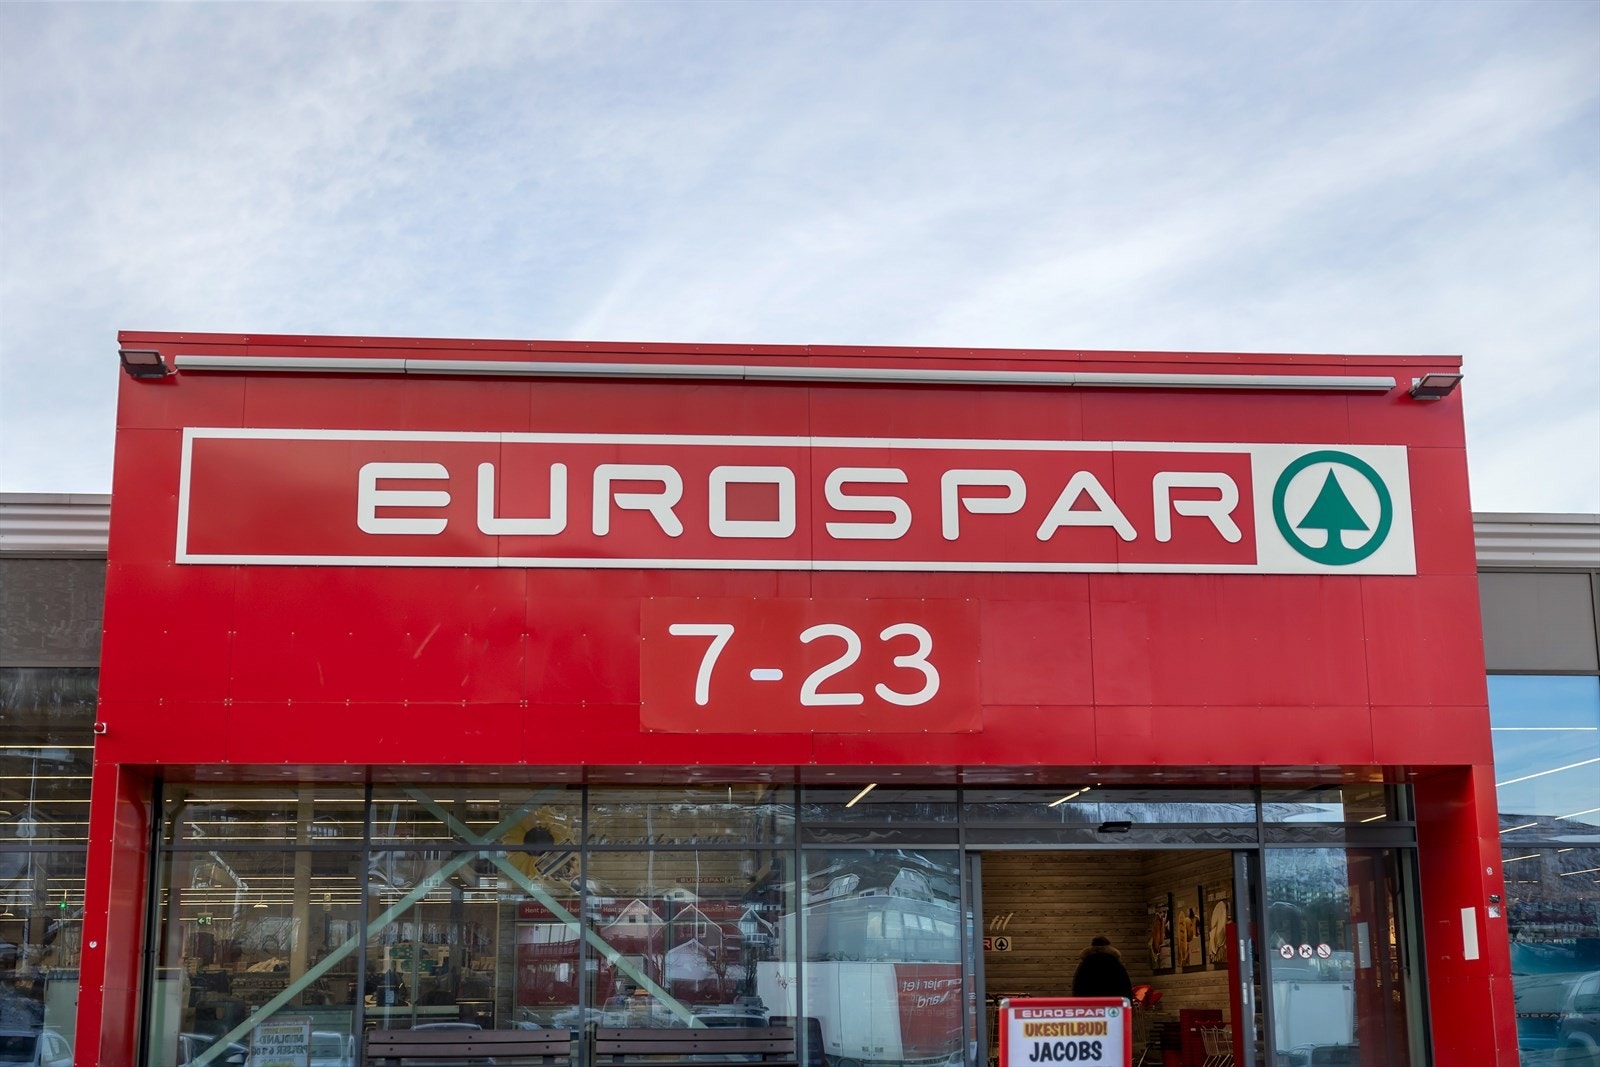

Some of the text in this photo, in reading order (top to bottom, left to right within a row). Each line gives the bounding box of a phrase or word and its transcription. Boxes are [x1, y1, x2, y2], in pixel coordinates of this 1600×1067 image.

[357, 461, 1242, 543] EUROSPAR
[668, 623, 940, 707] 7-23
[990, 912, 1013, 931] til
[1022, 1008, 1105, 1018] EUROSPAR
[1025, 1021, 1108, 1037] UKESTILBUD!
[1029, 1041, 1103, 1063] JACOBS
